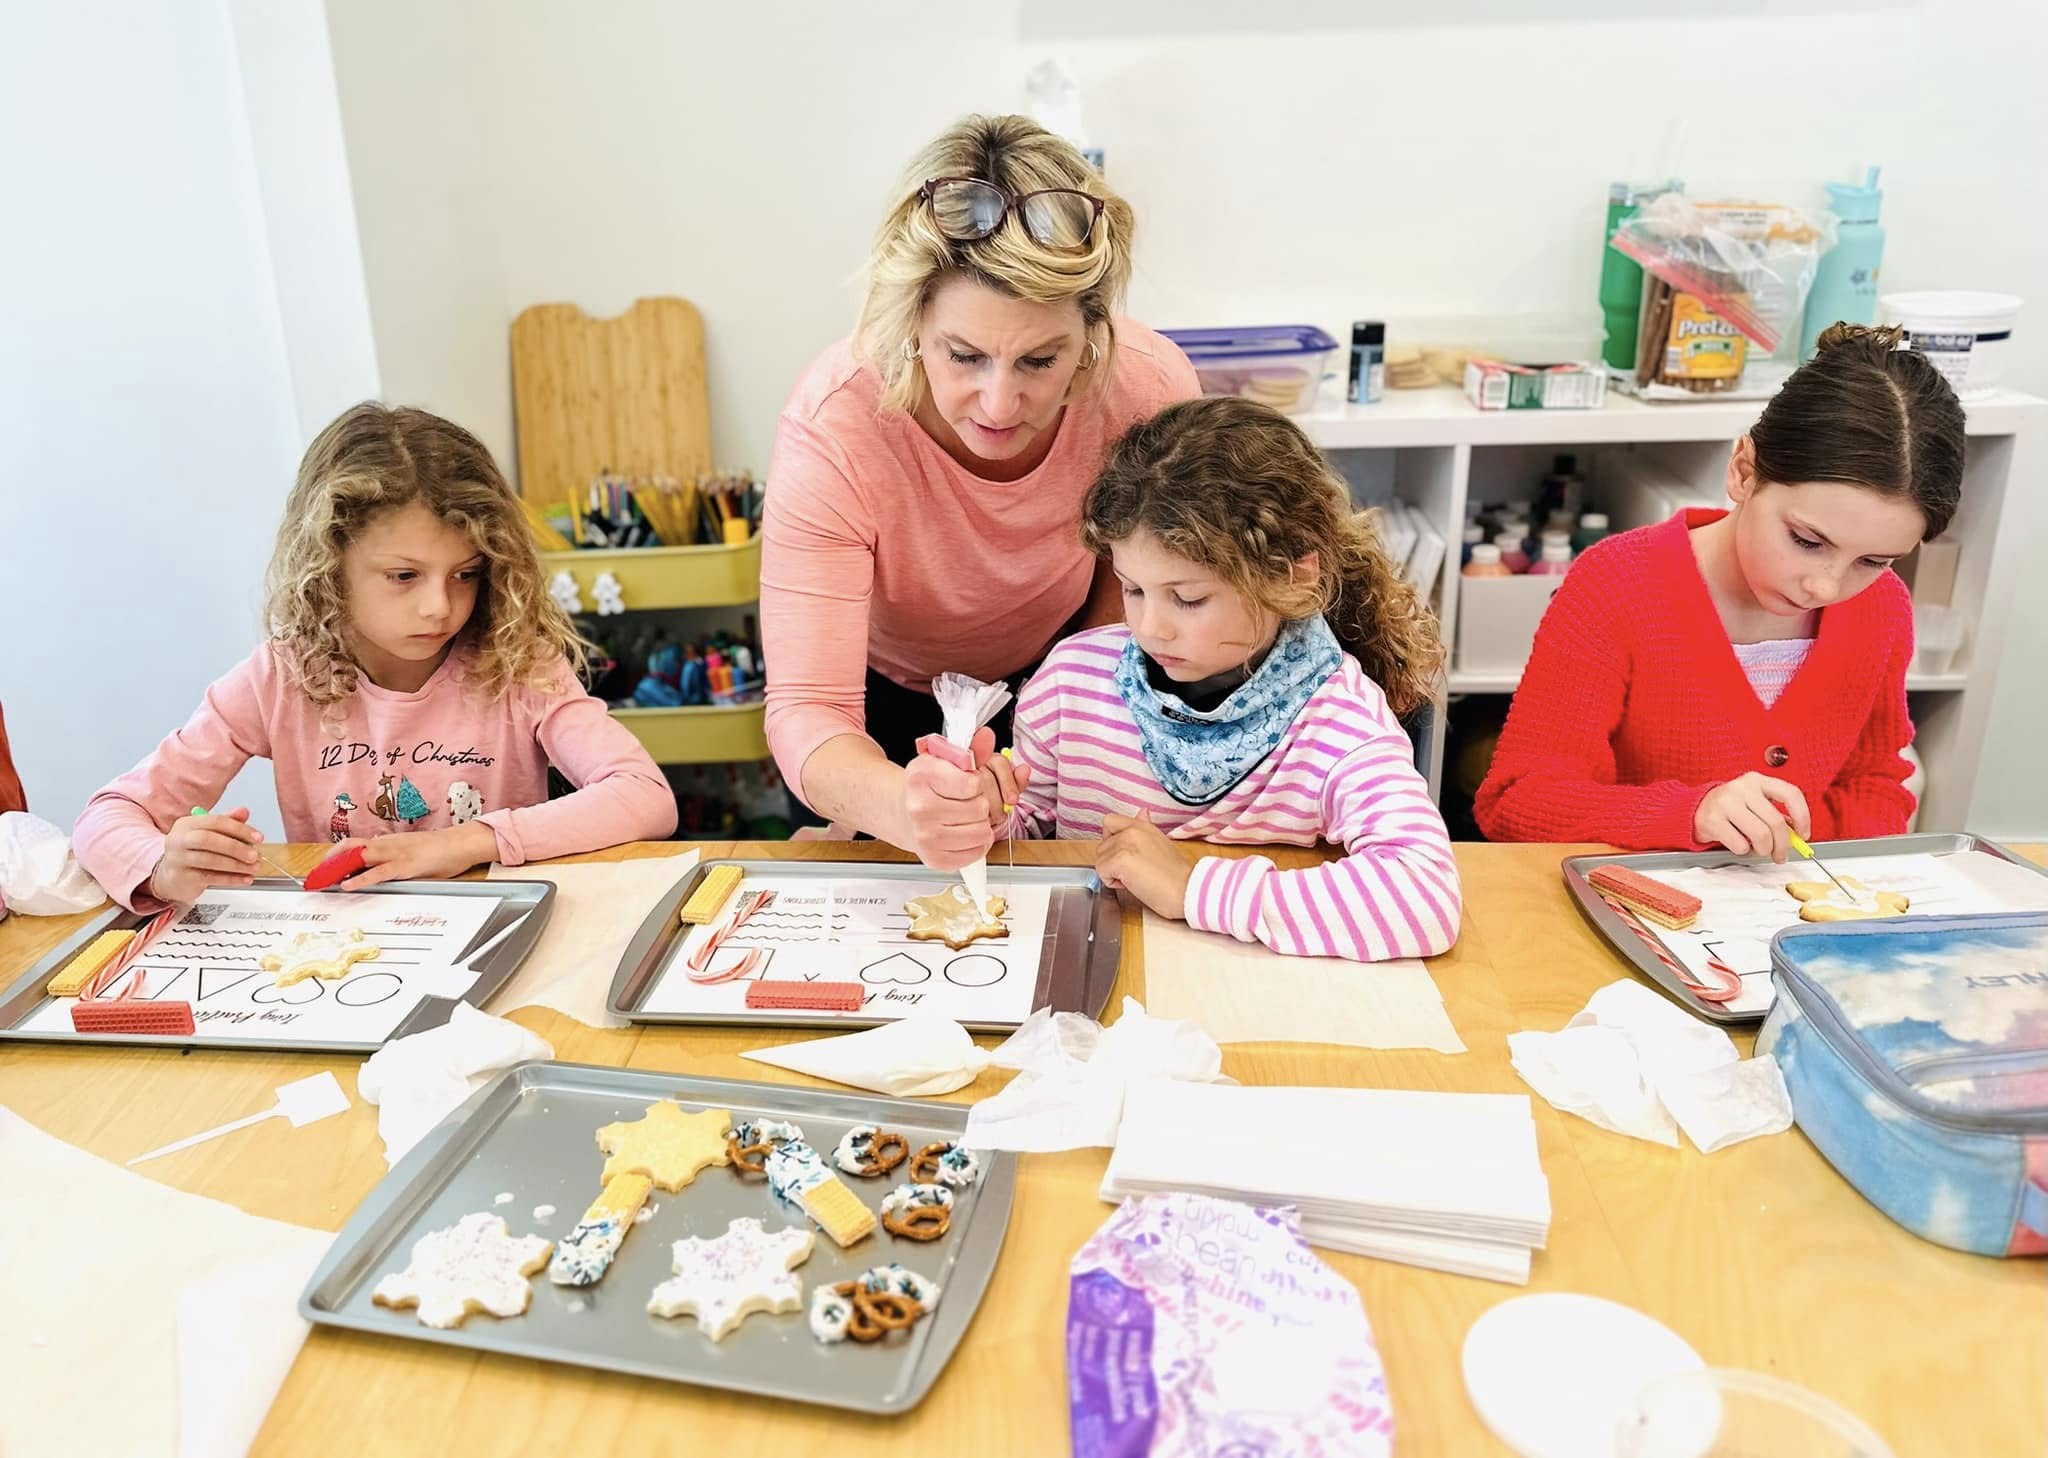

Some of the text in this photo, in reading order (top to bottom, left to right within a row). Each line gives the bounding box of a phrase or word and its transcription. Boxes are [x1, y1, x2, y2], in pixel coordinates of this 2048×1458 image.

[319, 745, 342, 770] 12
[386, 746, 406, 764] of
[412, 740, 495, 767] Christmas
[884, 988, 927, 1005] Icing
